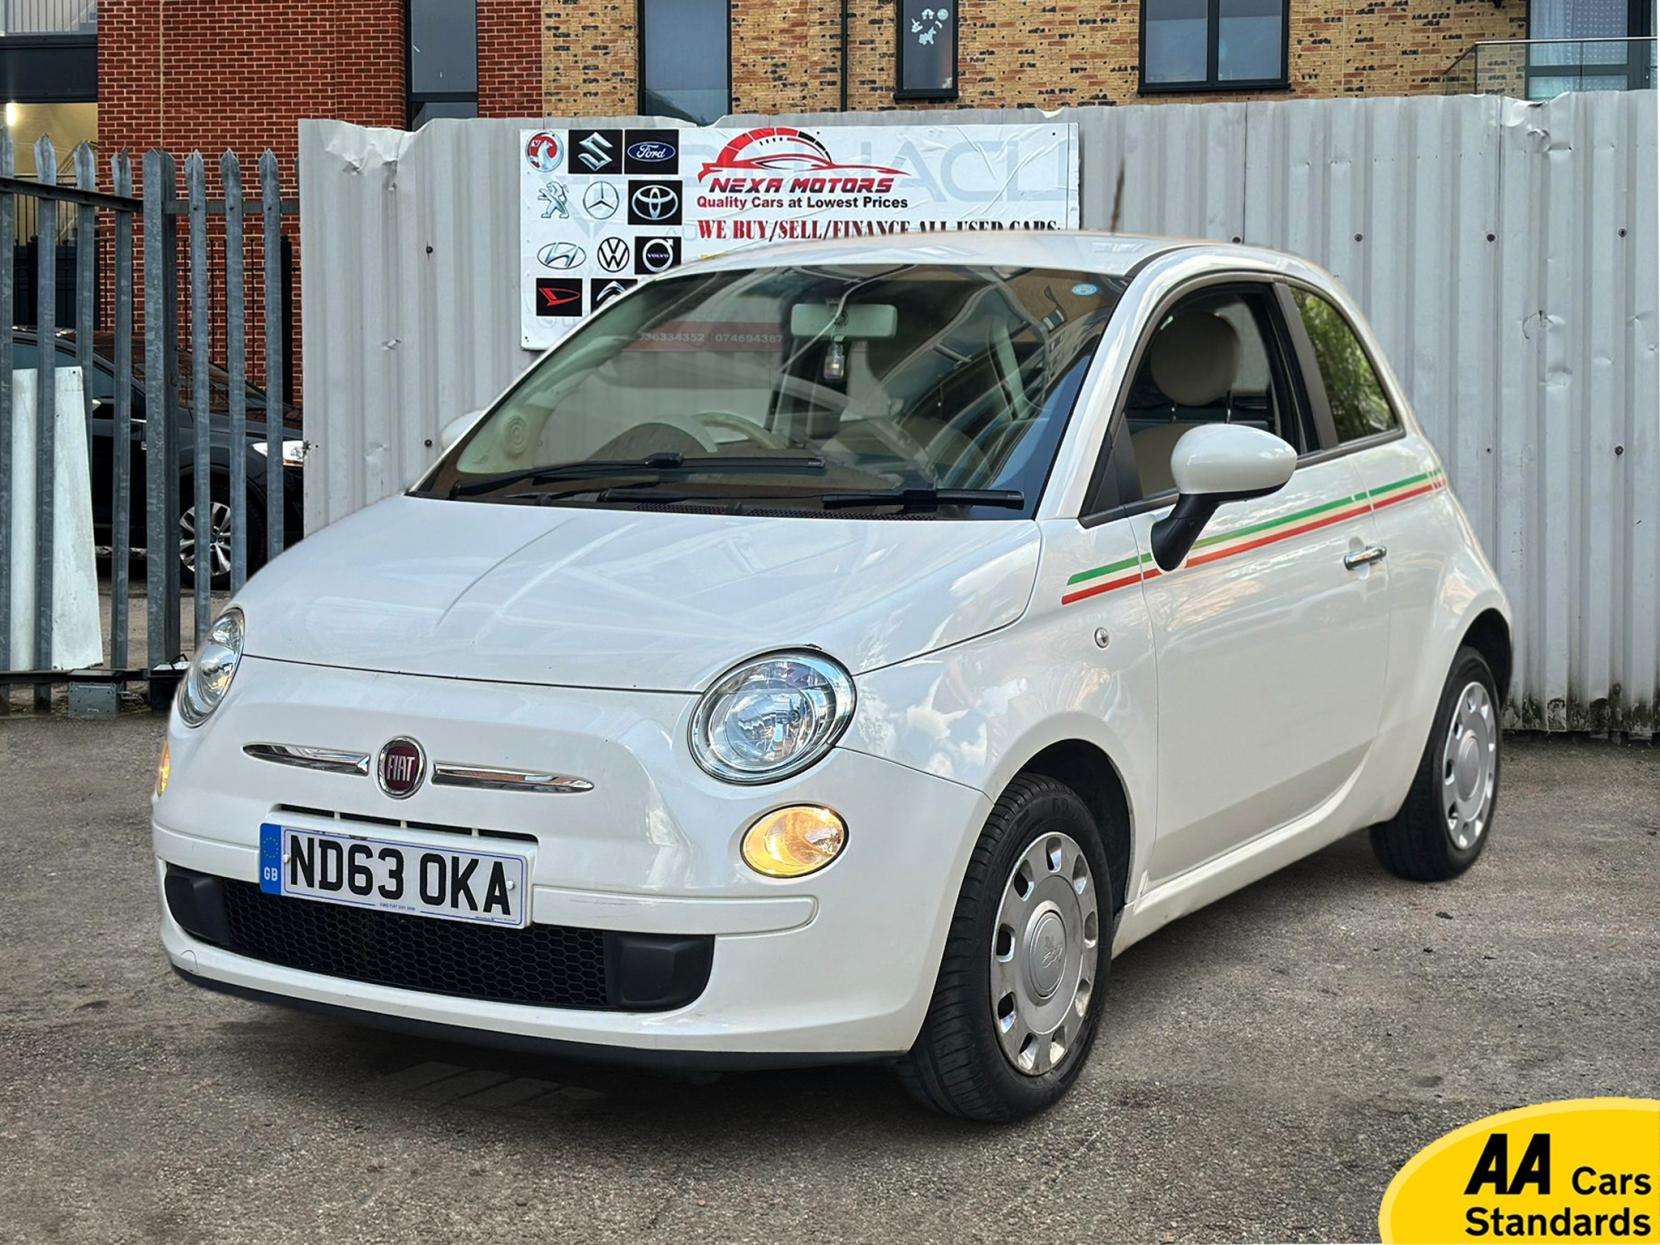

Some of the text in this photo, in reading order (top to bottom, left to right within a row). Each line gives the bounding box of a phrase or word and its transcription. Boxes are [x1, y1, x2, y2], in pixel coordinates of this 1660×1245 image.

[635, 144, 667, 159] Ford
[709, 178, 894, 194] NEXA MOTORS
[697, 196, 908, 210] Quality Cars at Lowest Prices
[697, 220, 727, 239] WE
[387, 754, 415, 782] FIAT
[263, 866, 279, 882] GB
[290, 835, 511, 916] ND63 OKA
